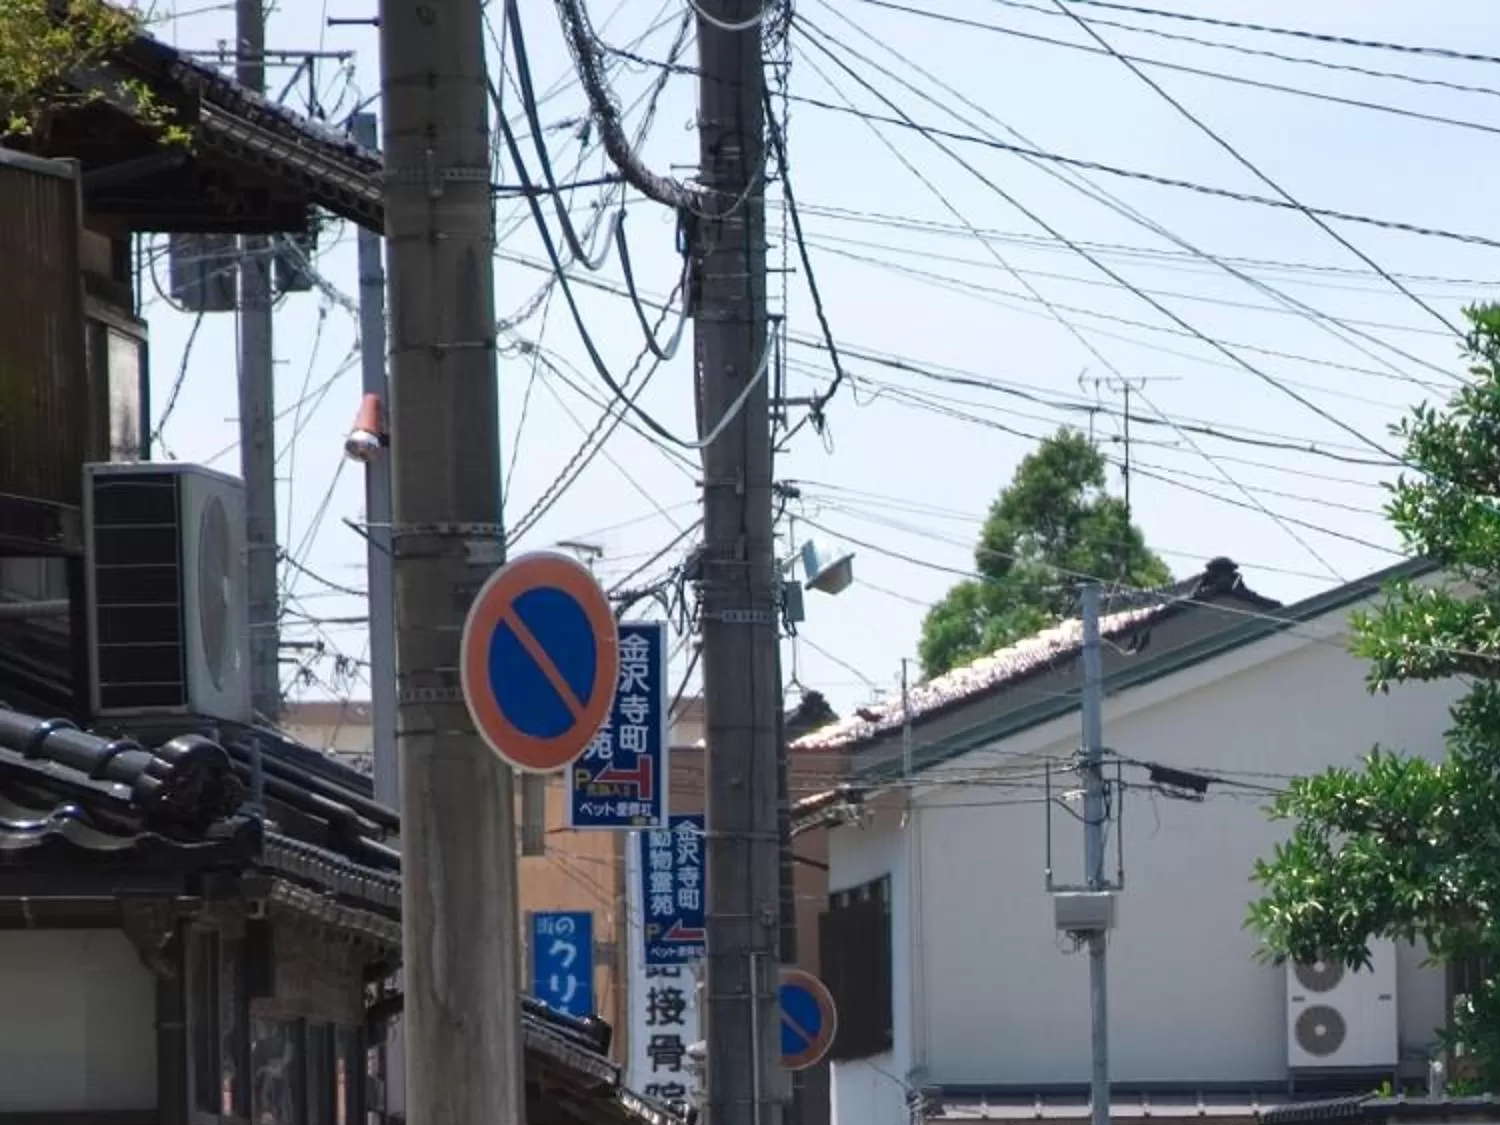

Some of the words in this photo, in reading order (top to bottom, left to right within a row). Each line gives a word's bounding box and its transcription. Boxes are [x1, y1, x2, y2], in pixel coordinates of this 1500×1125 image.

[618, 633, 650, 753] 金沢寺町
[676, 819, 700, 911] 金沢寺町
[548, 938, 577, 1014] クリ
[645, 964, 686, 1104] 接骨院
